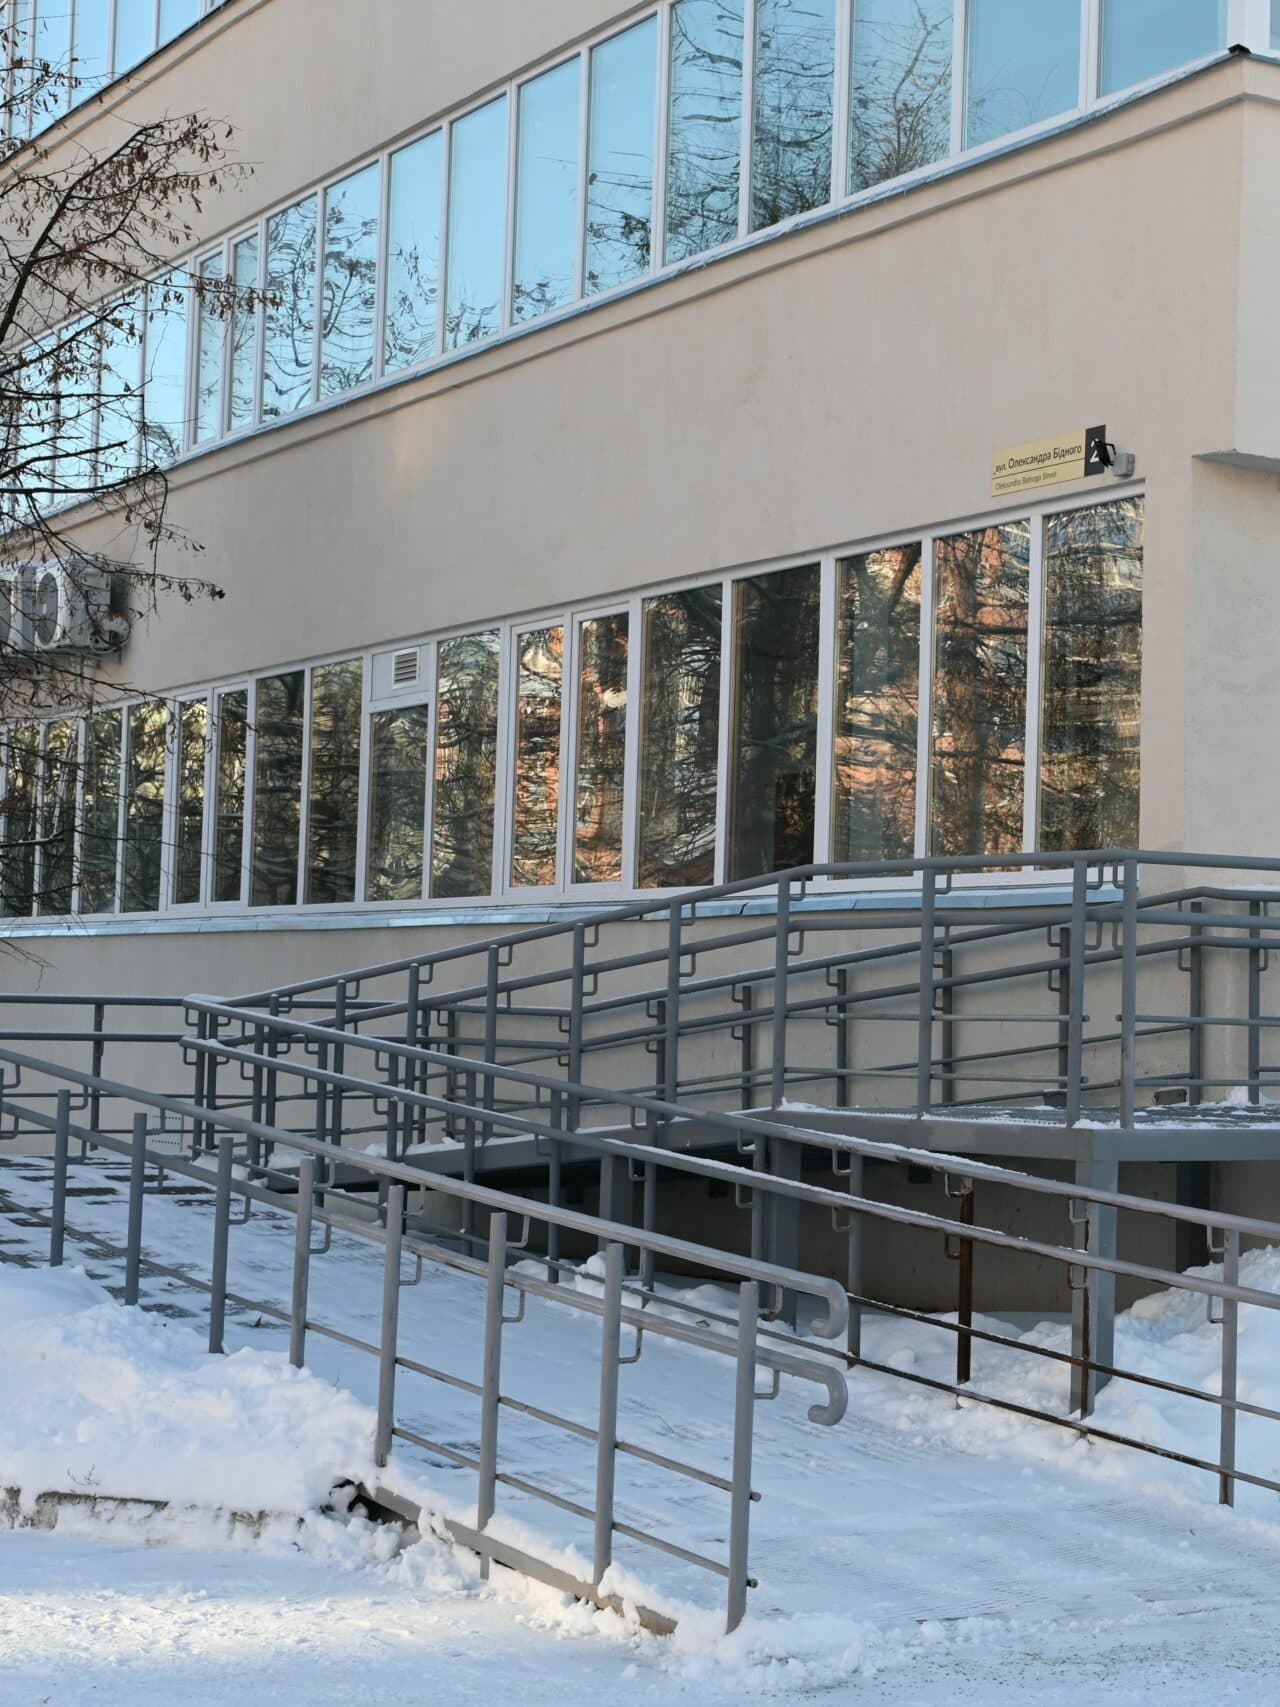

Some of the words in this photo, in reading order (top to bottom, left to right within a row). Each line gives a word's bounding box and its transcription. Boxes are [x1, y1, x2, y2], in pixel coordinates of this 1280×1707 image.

[1008, 451, 1052, 469] Олександра
[1053, 444, 1082, 460] Бідного
[1042, 471, 1057, 481] Street
